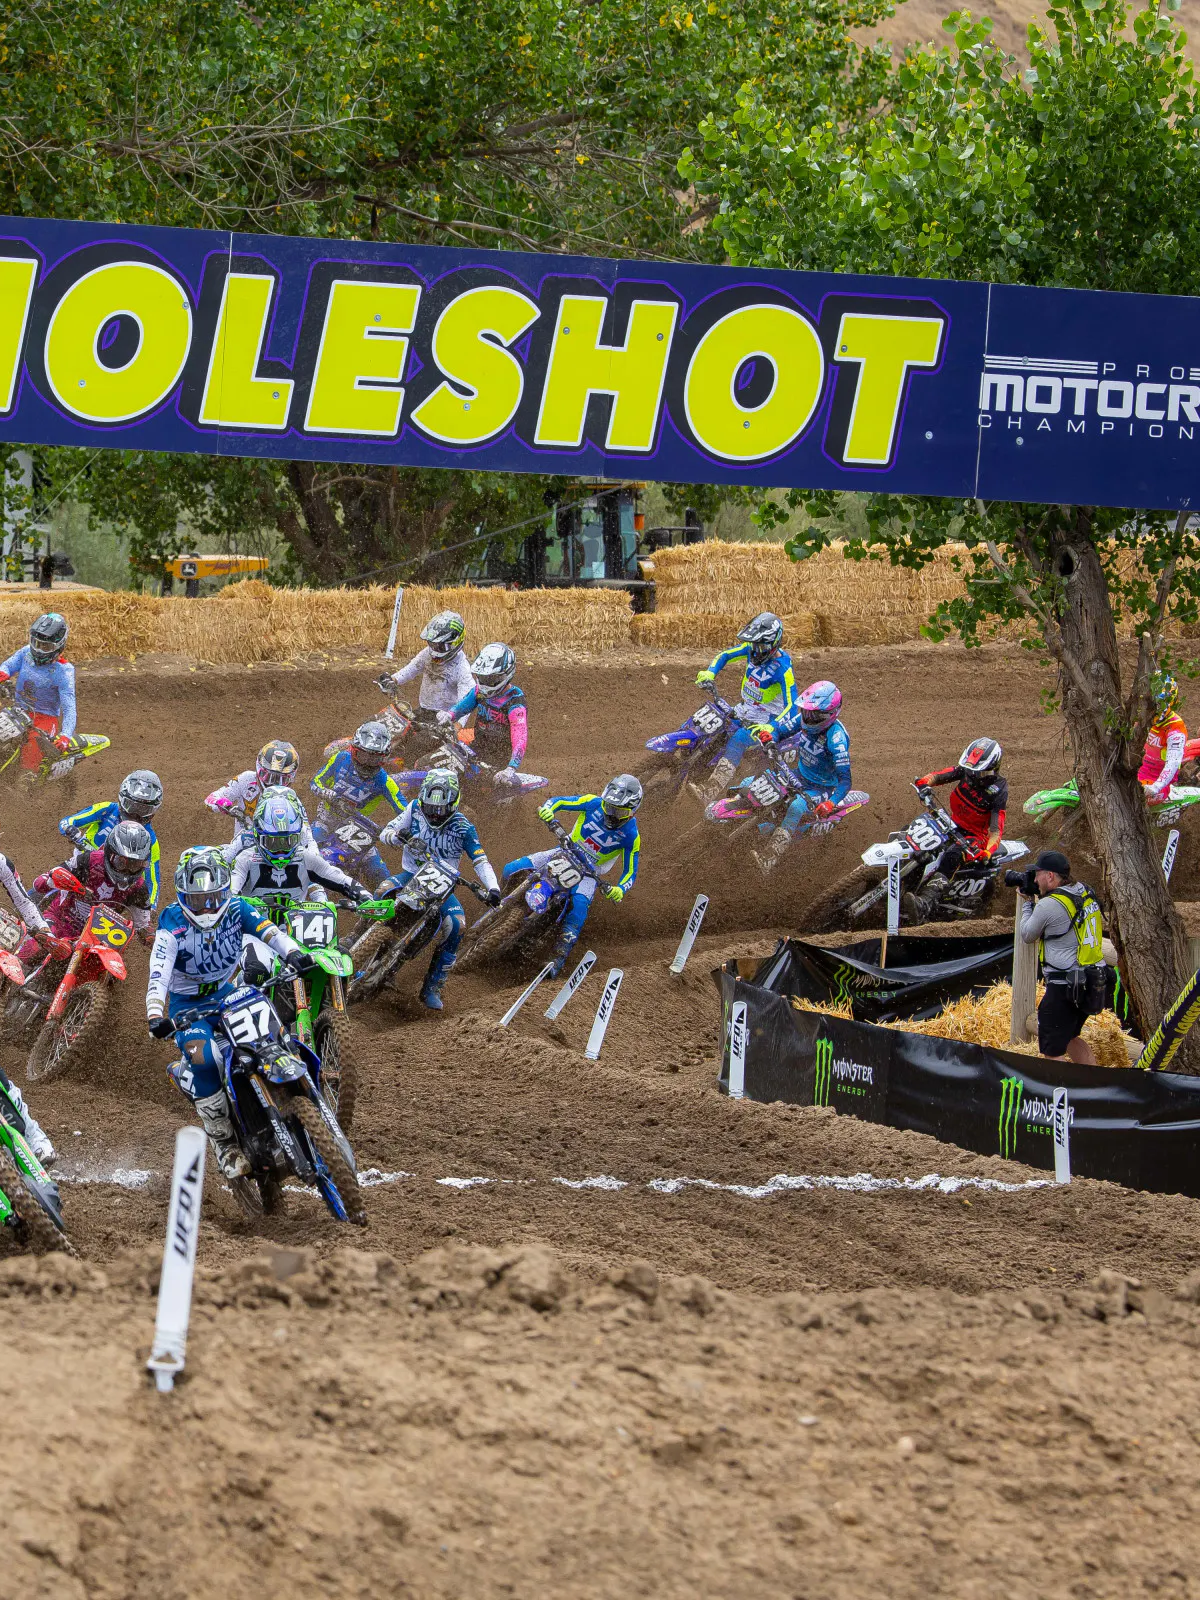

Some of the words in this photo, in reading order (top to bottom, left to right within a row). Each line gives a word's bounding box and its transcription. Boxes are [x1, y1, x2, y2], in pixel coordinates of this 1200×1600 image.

[1102, 362, 1185, 380] PRO
[692, 703, 725, 735] 443
[749, 773, 781, 807] 800
[907, 816, 943, 851] 300
[416, 870, 453, 895] 25
[547, 858, 582, 889] 40
[949, 877, 987, 896] 300
[91, 916, 128, 946] 30
[291, 914, 335, 946] 141
[688, 909, 701, 934] UFO
[598, 989, 612, 1018] UFO
[227, 1000, 271, 1044] 37
[732, 1024, 741, 1057] UFO
[833, 1058, 874, 1085] MONSTER
[837, 1083, 867, 1097] ENERGY
[1022, 1097, 1075, 1125] MONSR
[1026, 1124, 1055, 1136] ENER
